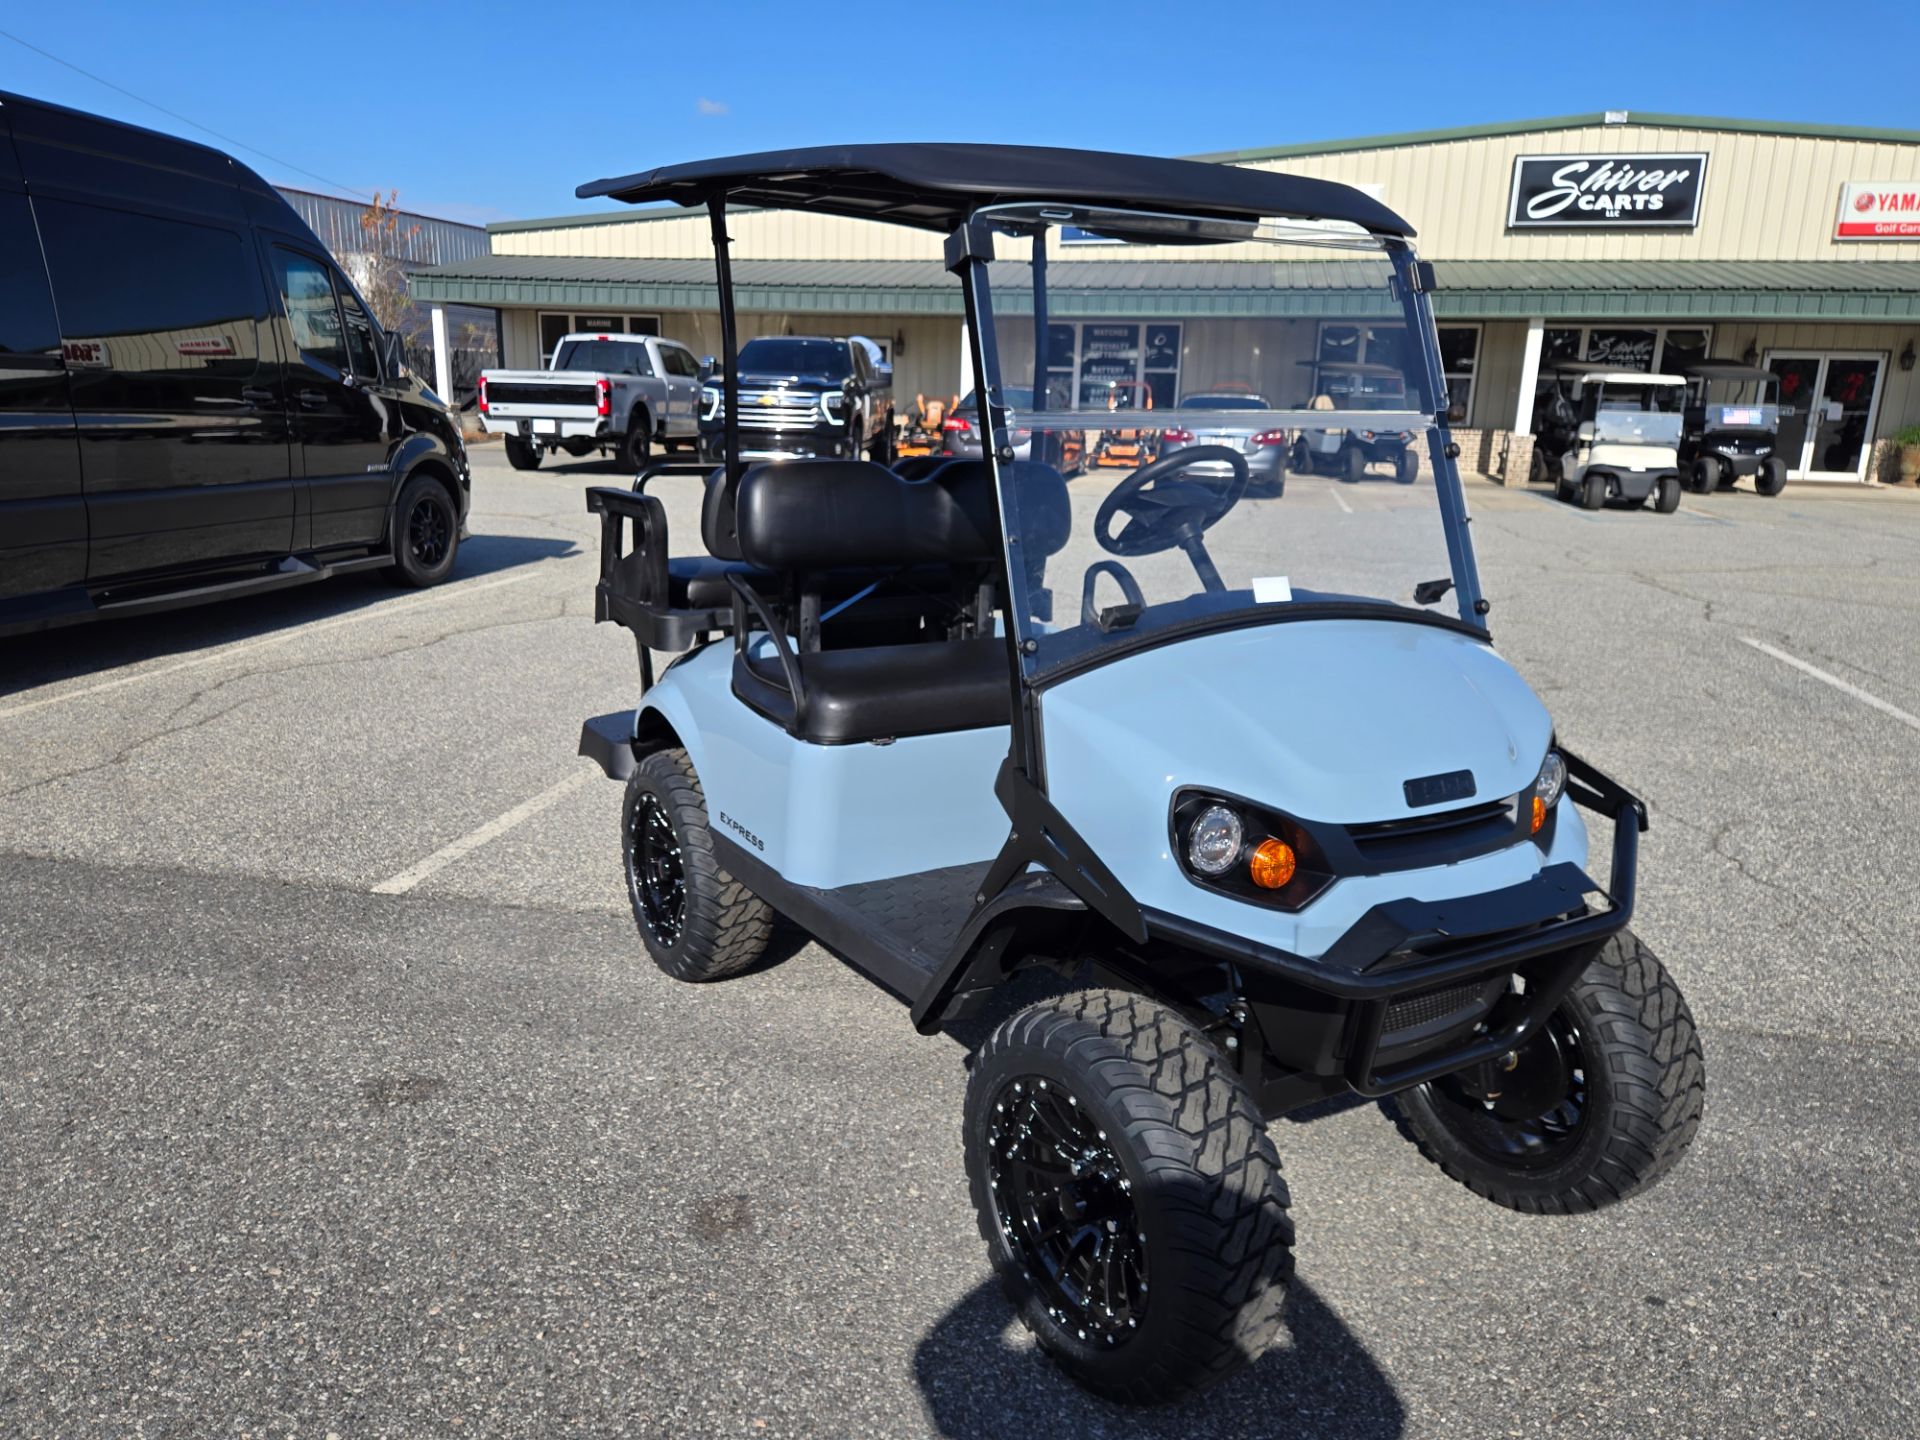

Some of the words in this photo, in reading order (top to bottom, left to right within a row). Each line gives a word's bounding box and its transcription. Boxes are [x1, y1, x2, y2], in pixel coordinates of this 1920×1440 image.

[1526, 160, 1690, 219] Shiver
[1577, 194, 1664, 211] CARTS
[1605, 210, 1620, 218] LLC
[1874, 223, 1897, 234] Golf
[1899, 223, 1920, 234] Car
[720, 811, 765, 852] EXPRESS
